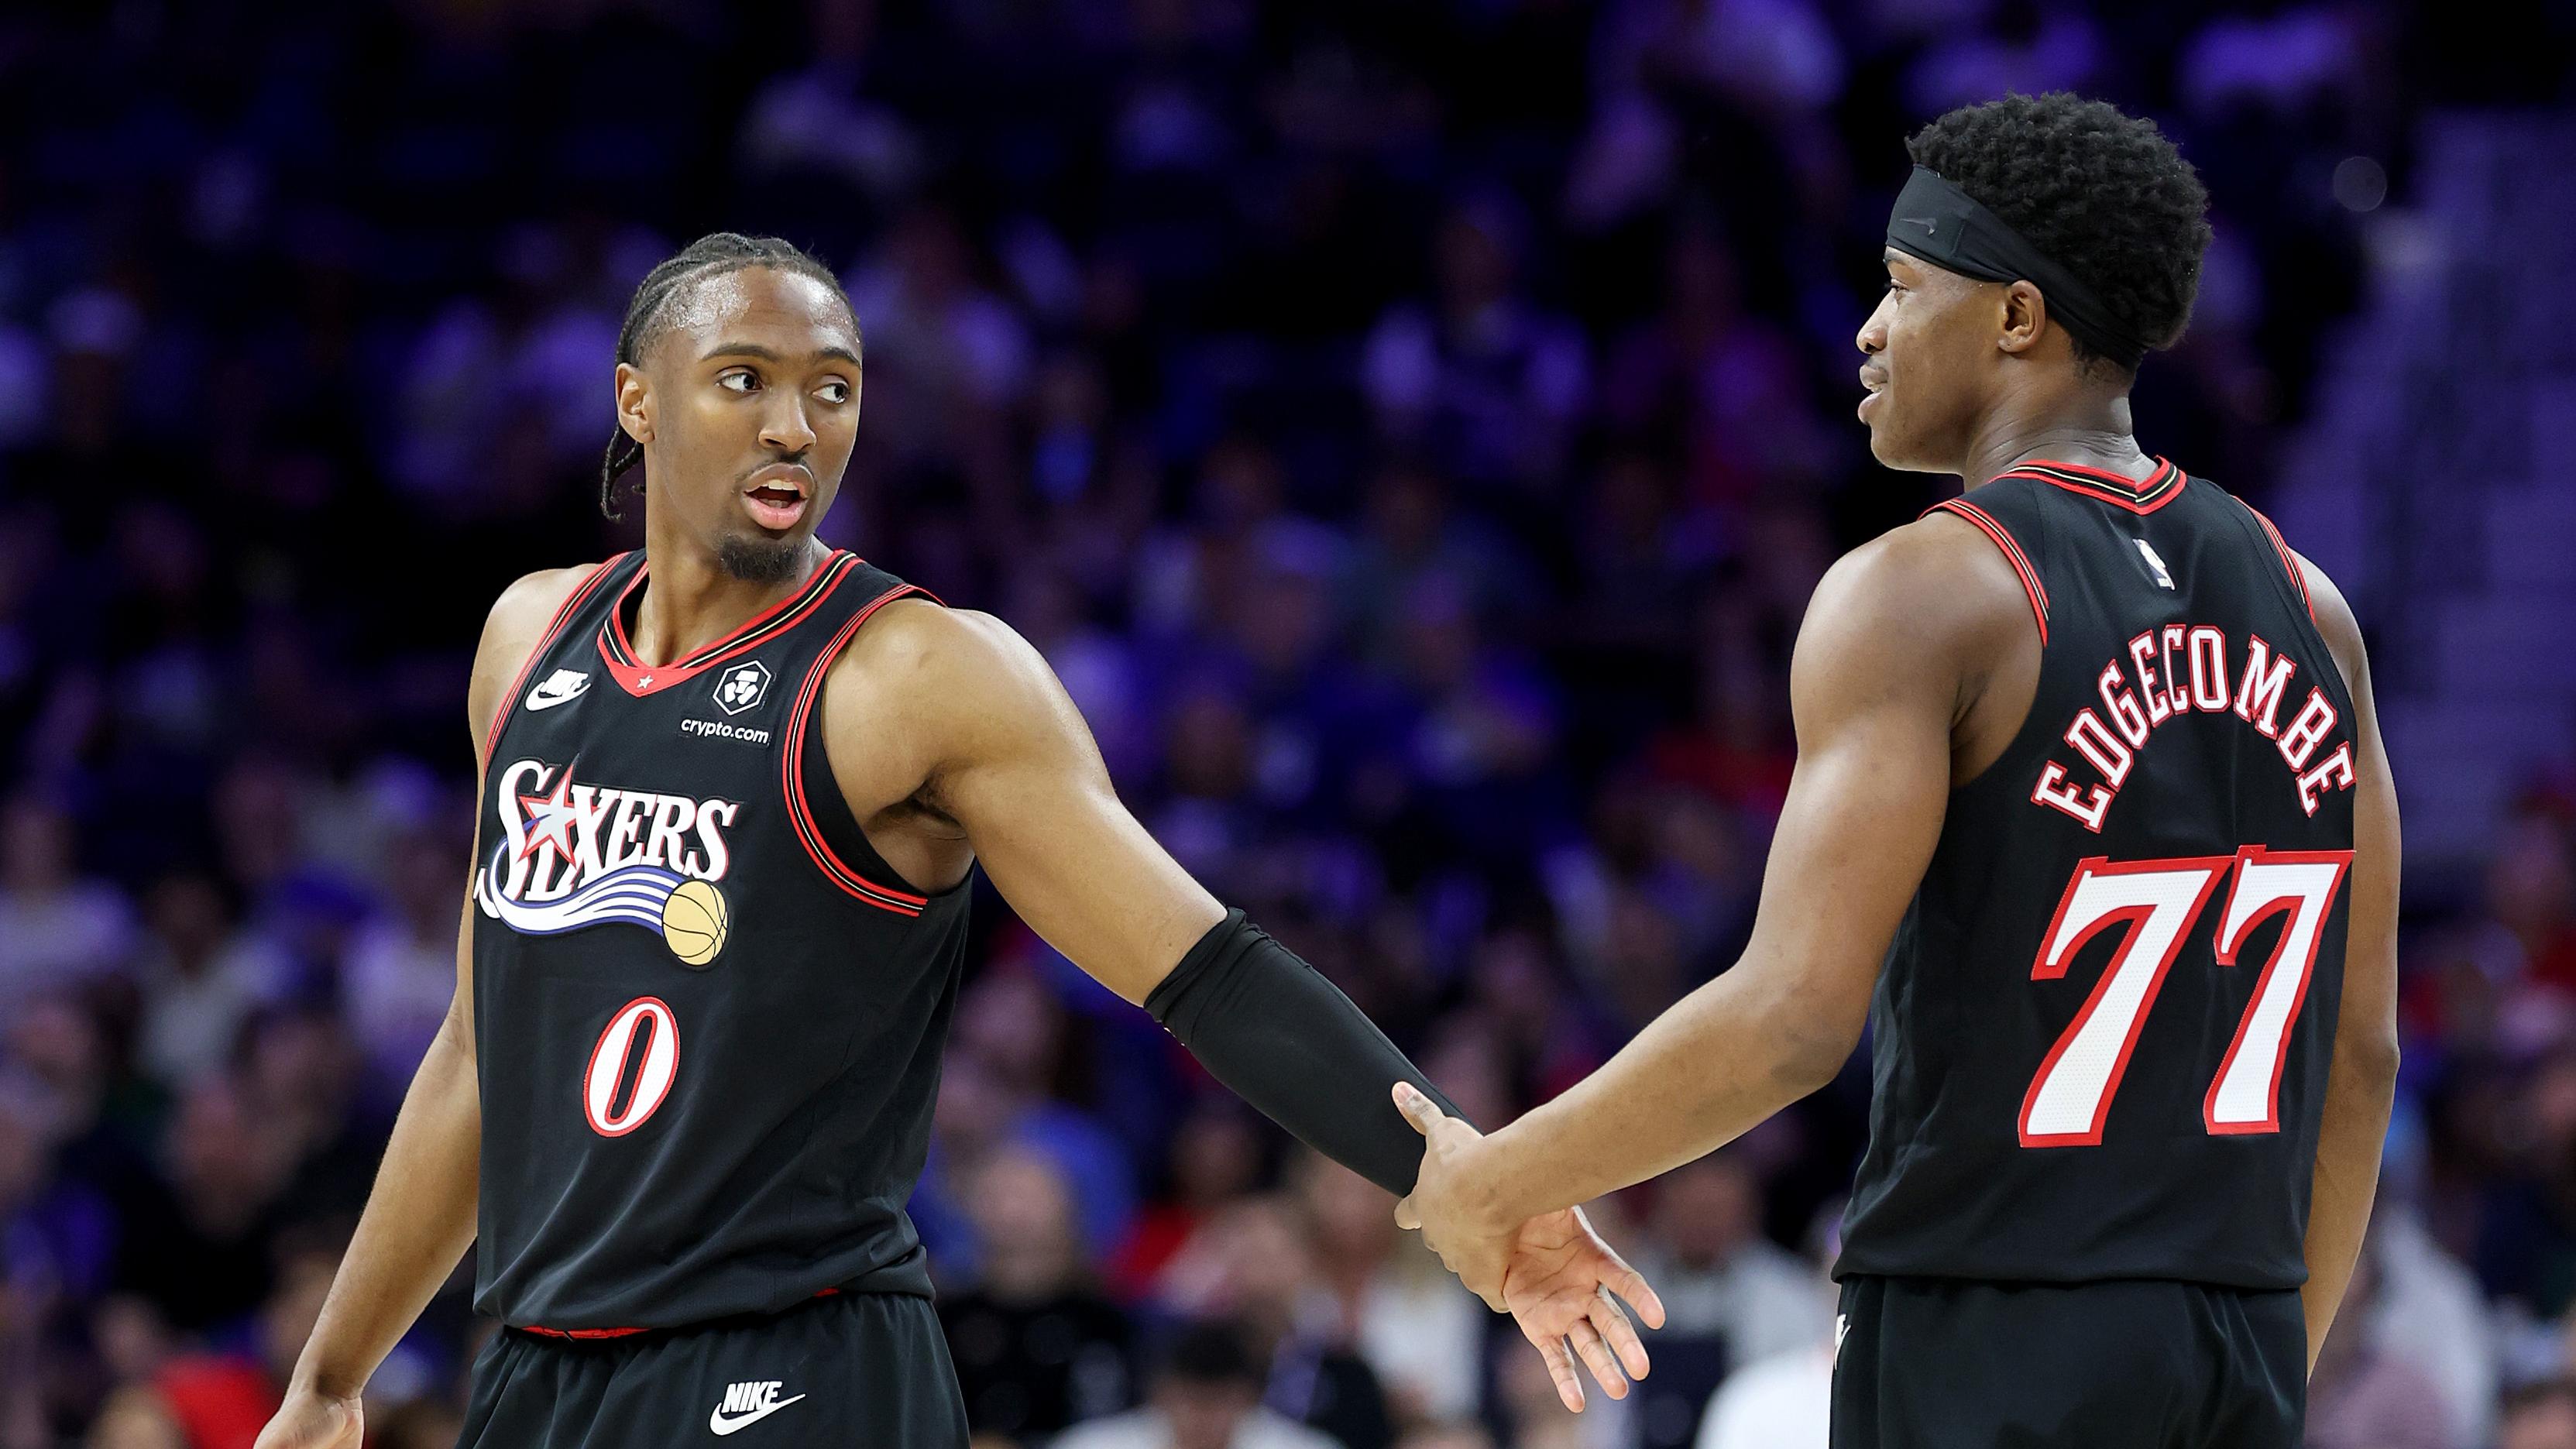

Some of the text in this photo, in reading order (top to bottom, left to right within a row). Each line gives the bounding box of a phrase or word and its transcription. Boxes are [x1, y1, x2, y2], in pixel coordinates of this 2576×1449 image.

[539, 668, 589, 696] NIKE
[681, 719, 769, 743] crypto.com
[2031, 624, 2357, 833] EDGECOMBE
[473, 759, 740, 919] SIXERS
[583, 996, 681, 1138] 0
[2018, 844, 2357, 1148] 77
[721, 1381, 783, 1413] NIKE
